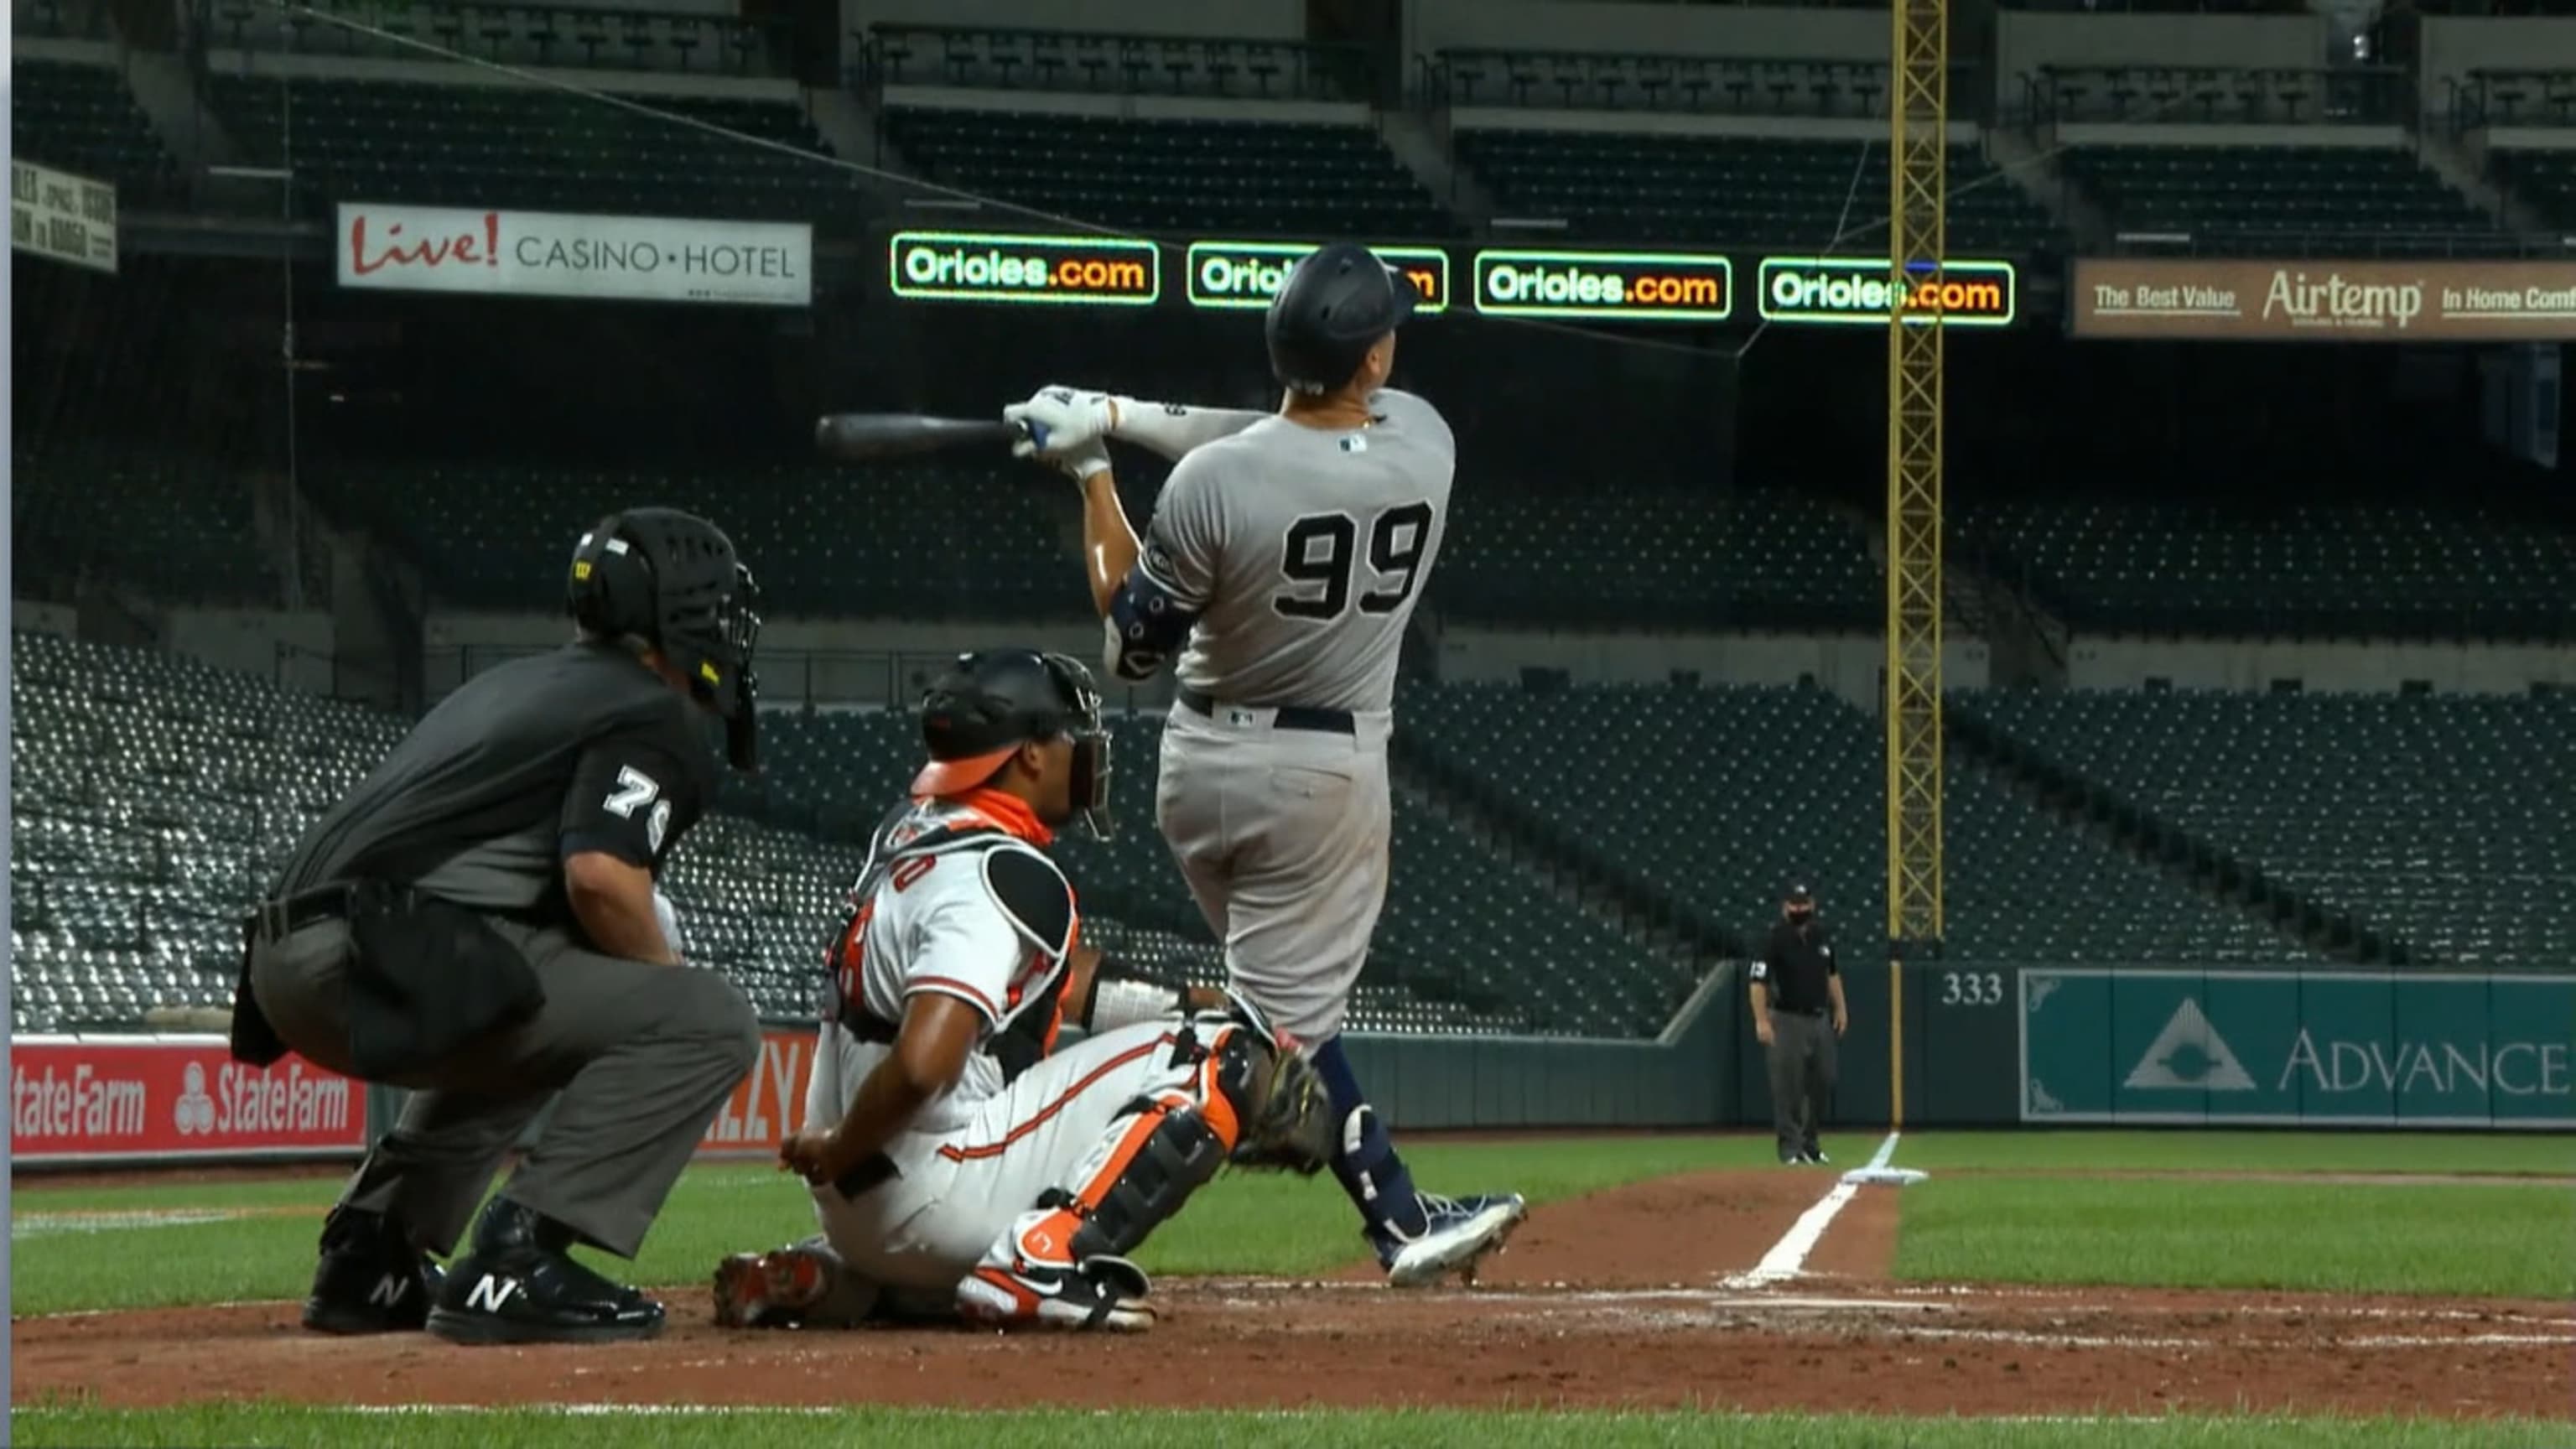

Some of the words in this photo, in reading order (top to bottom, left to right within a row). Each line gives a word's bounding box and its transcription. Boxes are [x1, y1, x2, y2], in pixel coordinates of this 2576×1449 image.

[352, 210, 498, 275] Live!
[516, 236, 659, 273] CASINO
[684, 244, 795, 279] HOTEL
[906, 247, 1145, 288] Orioles.com
[1488, 264, 1717, 304] Orioles.com
[2095, 286, 2128, 308] The
[2137, 286, 2178, 308] Best
[2182, 286, 2236, 309] Value
[2262, 270, 2422, 328] Airtemp
[2442, 287, 2461, 309] In
[2466, 287, 2521, 309] Home
[1270, 497, 1436, 625] 99
[1942, 972, 2003, 1005] 333
[2277, 1026, 2572, 1094] ADVANCE
[11, 1063, 146, 1137] tateFarm
